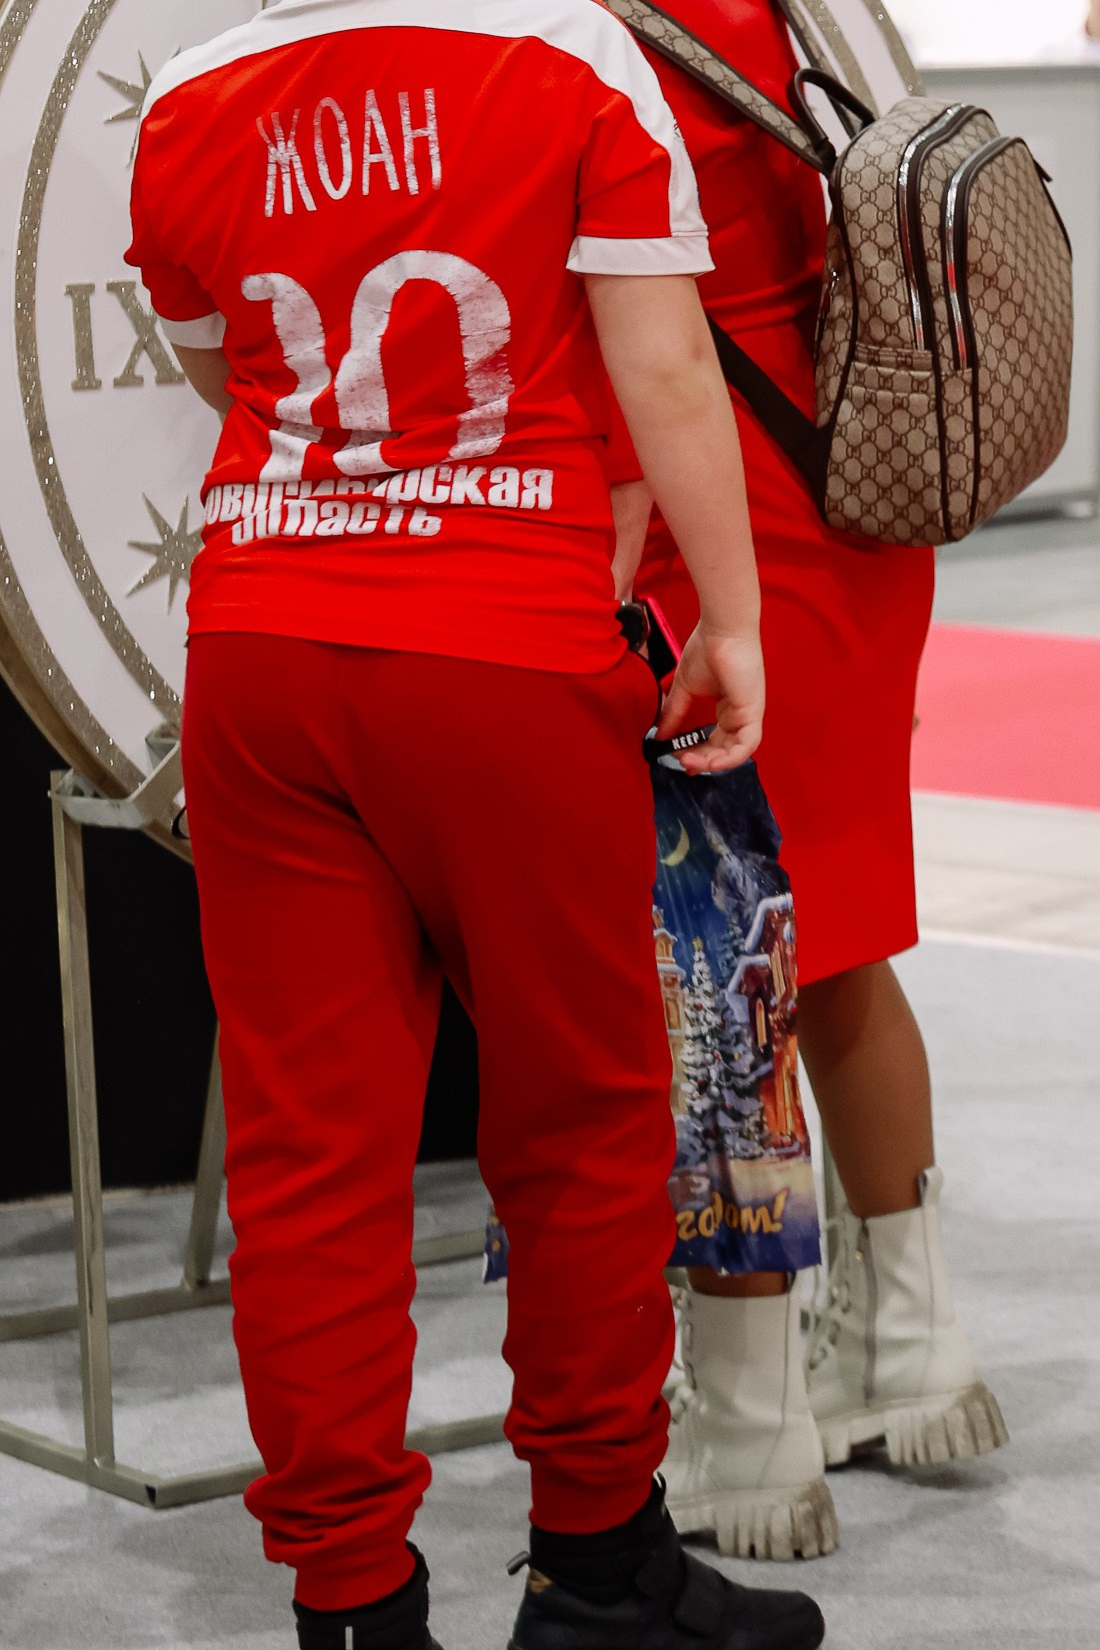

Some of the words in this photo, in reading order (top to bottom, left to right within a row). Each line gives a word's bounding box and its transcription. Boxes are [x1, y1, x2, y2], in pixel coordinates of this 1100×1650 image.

[65, 281, 186, 390] IX
[241, 250, 511, 482] 10
[671, 731, 700, 750] KEEP
